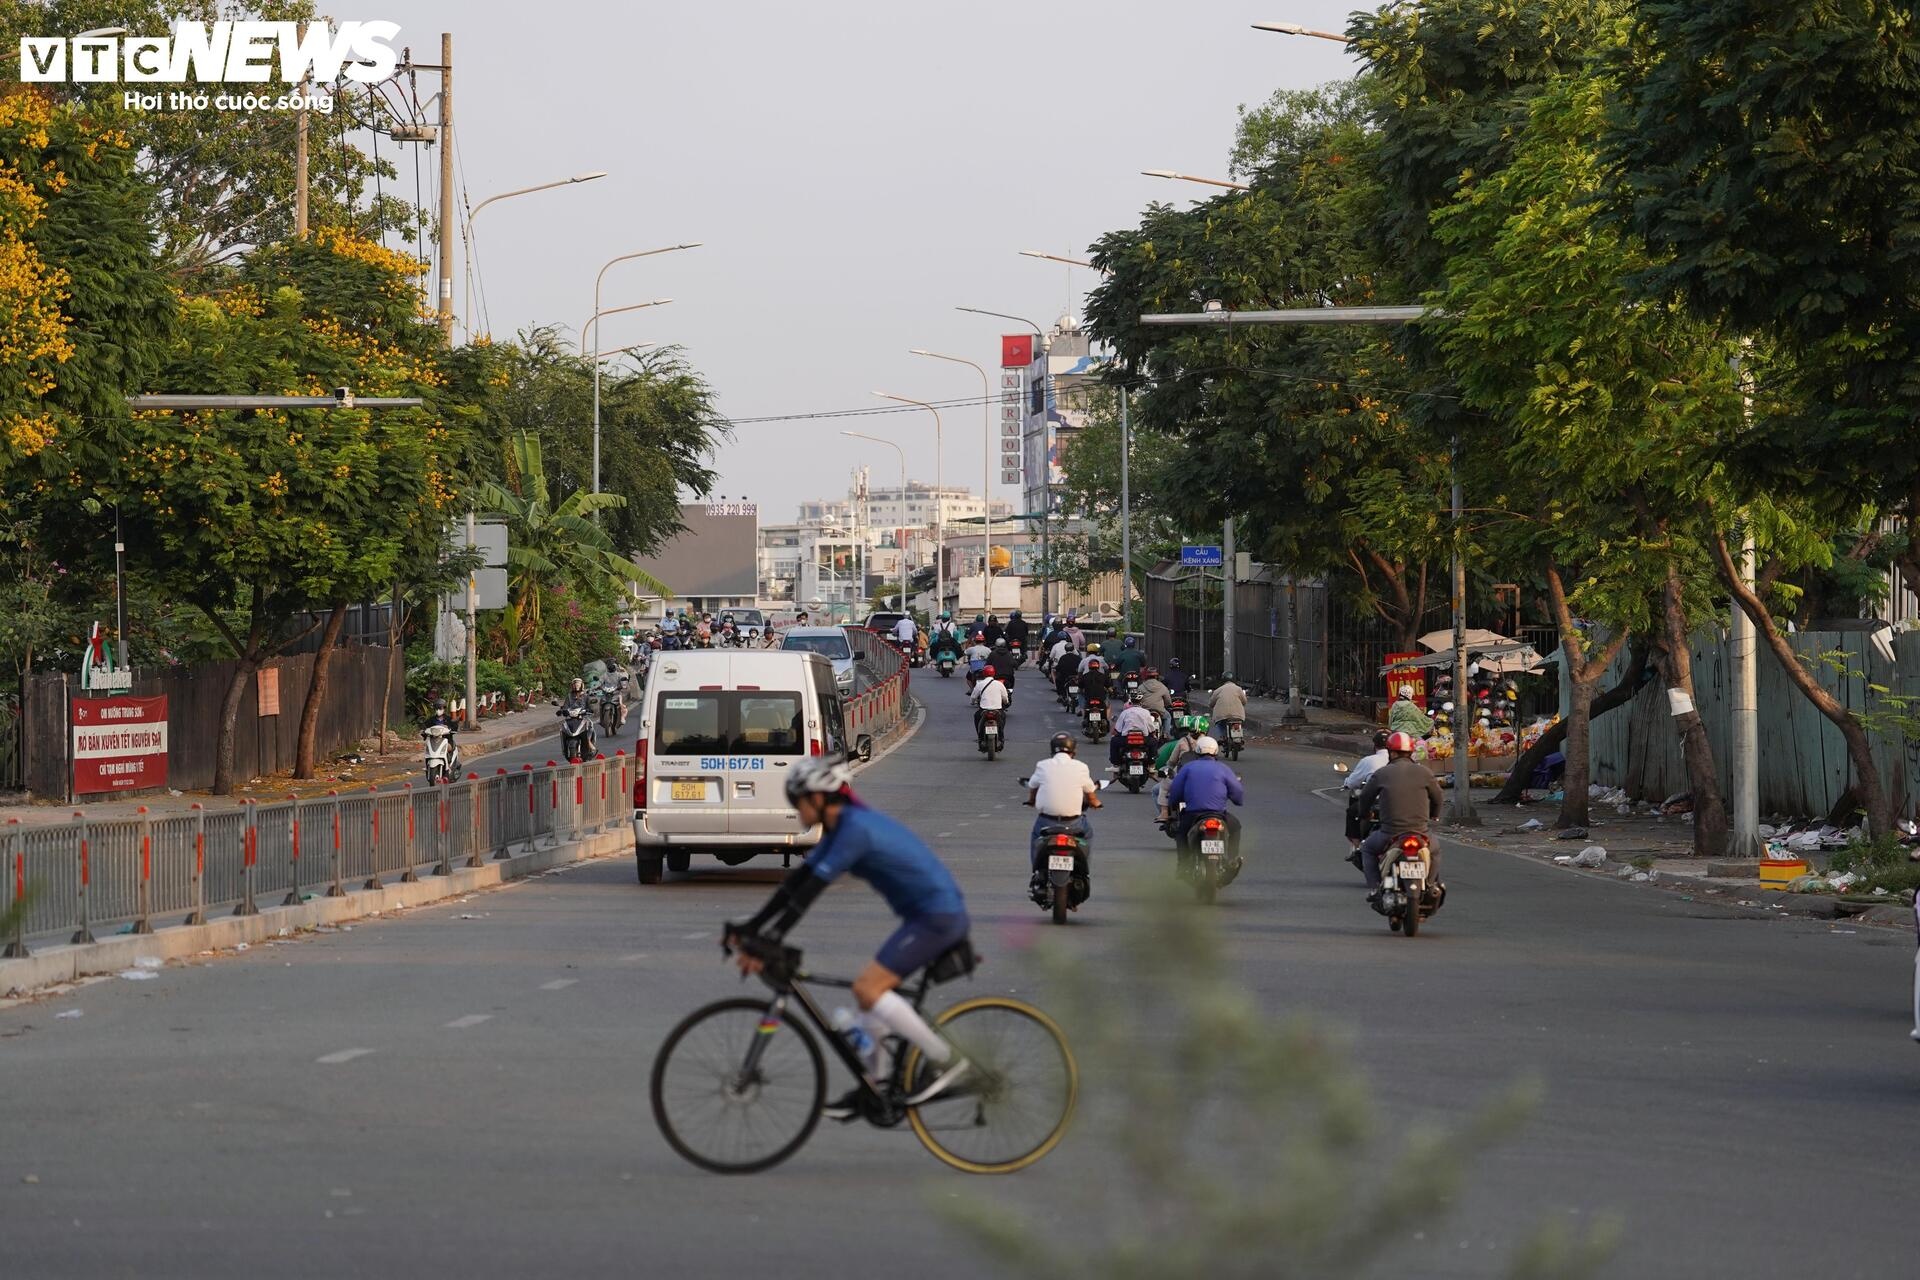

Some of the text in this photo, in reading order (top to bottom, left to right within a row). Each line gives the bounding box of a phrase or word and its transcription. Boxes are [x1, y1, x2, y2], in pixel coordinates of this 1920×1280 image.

[706, 504, 757, 515] 0935 220 999
[89, 732, 101, 751] BÁN
[101, 731, 120, 750] XUYÊN
[121, 729, 131, 749] TẾT
[131, 730, 151, 748] NGUYÊN
